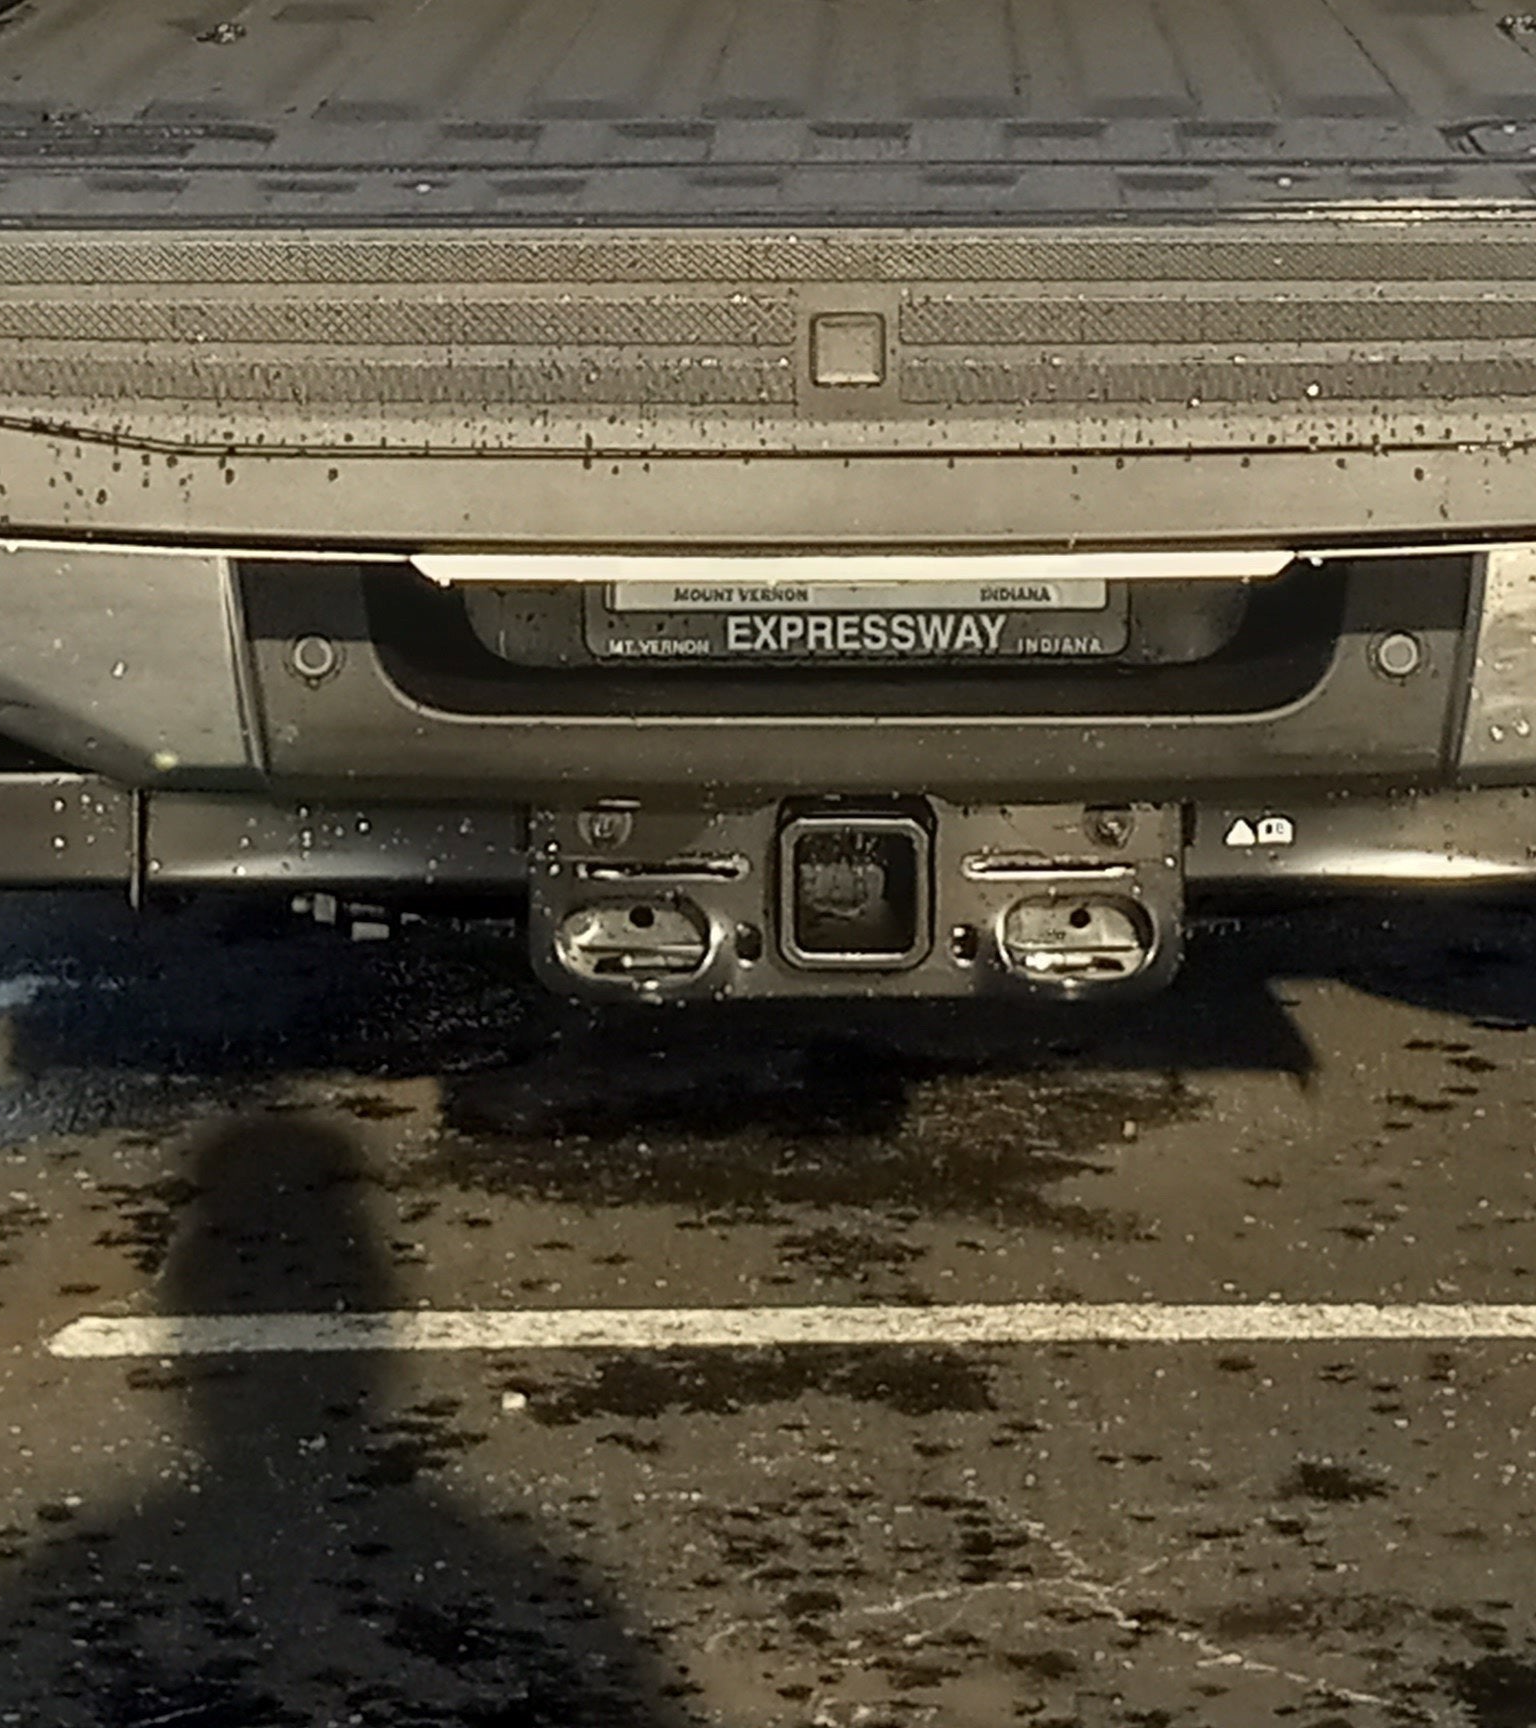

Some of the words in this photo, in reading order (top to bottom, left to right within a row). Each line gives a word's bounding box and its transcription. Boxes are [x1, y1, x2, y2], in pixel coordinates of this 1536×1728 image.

[673, 587, 734, 603] MOUNT
[737, 587, 809, 603] VERNON
[979, 586, 1052, 603] INDIANA
[726, 614, 1007, 651] EXPRESSWAY
[638, 639, 710, 655] VERNON
[1017, 637, 1104, 654] INDIANA
